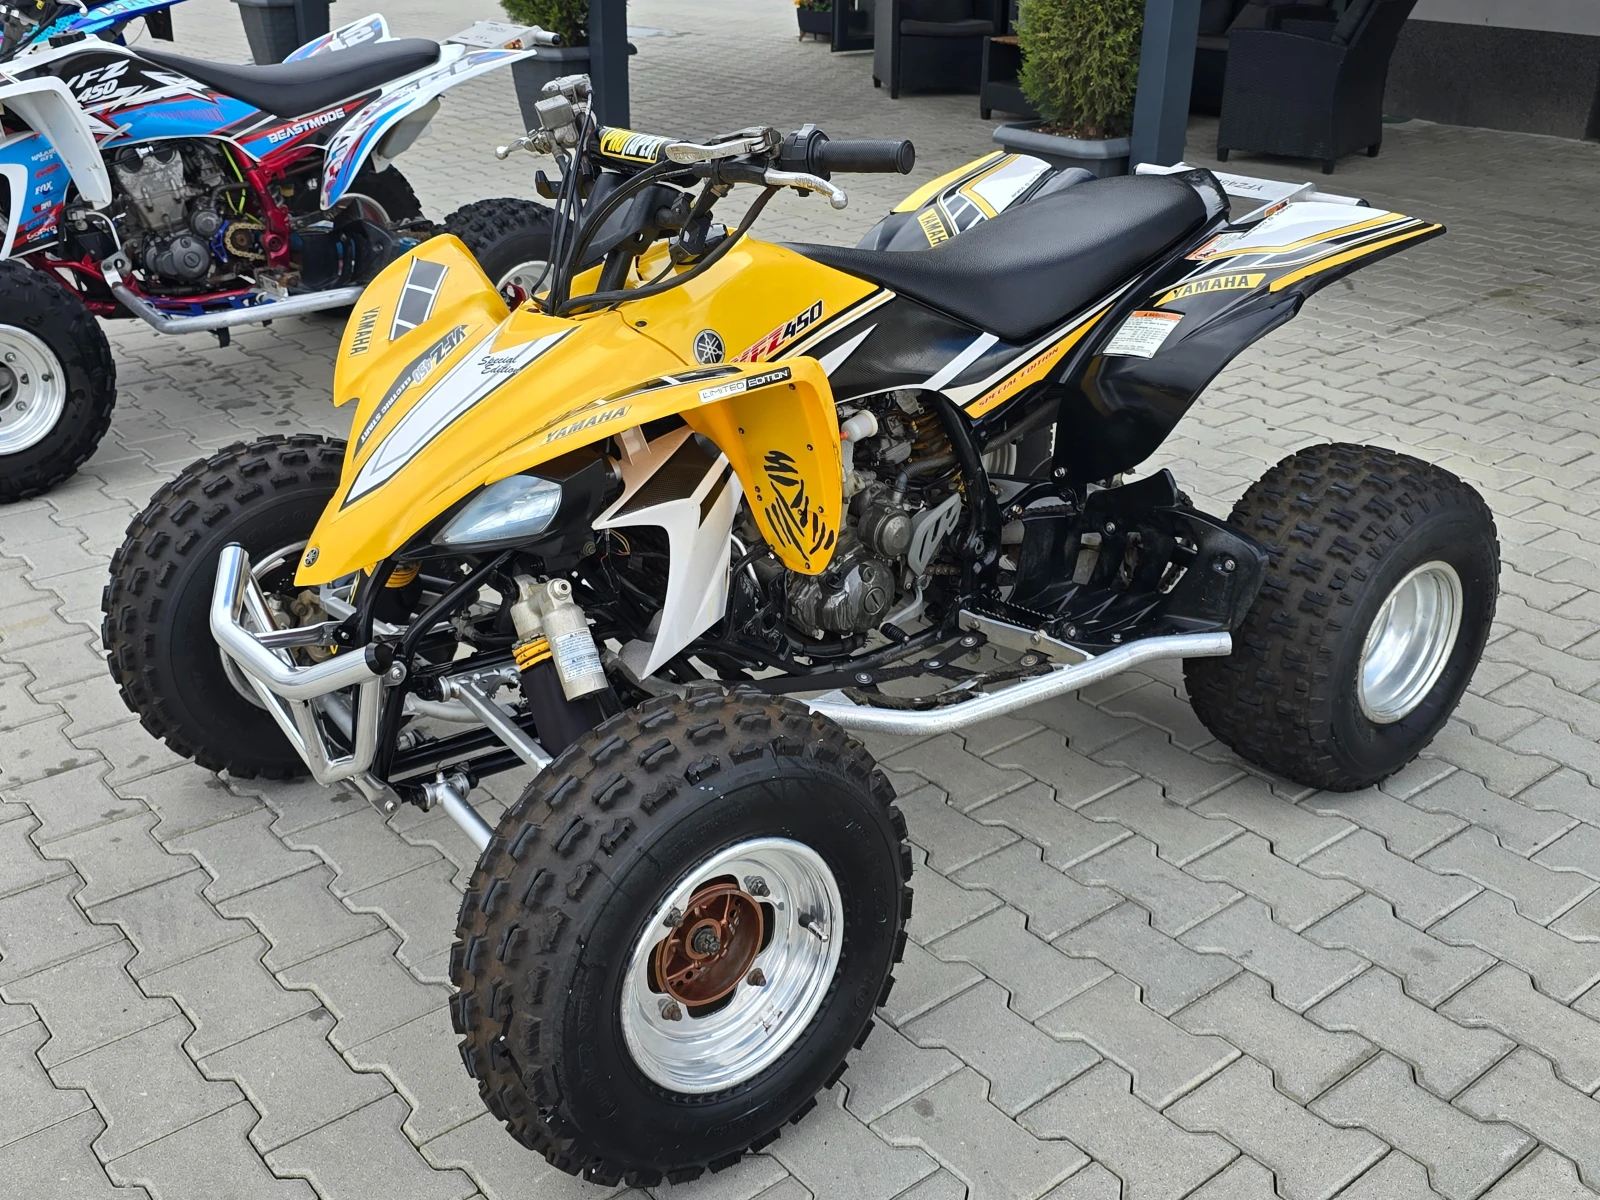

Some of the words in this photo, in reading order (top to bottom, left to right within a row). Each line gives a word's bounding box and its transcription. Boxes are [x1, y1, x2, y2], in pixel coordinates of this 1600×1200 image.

[77, 79, 118, 102] 450
[267, 108, 345, 144] BEASTMODE
[1219, 179, 1263, 191] YFZ45
[921, 212, 947, 245] YAMAH
[1173, 275, 1249, 299] YAMAHA
[351, 307, 380, 356] YAMAHA
[478, 356, 517, 366] Special
[481, 364, 521, 374] Edition
[702, 382, 745, 399] LIMITED
[748, 369, 789, 387] EDITION
[978, 378, 1018, 408] SPECIAL
[1020, 347, 1059, 378] EDITION
[361, 413, 382, 443] START
[545, 407, 627, 443] YAMAHA
